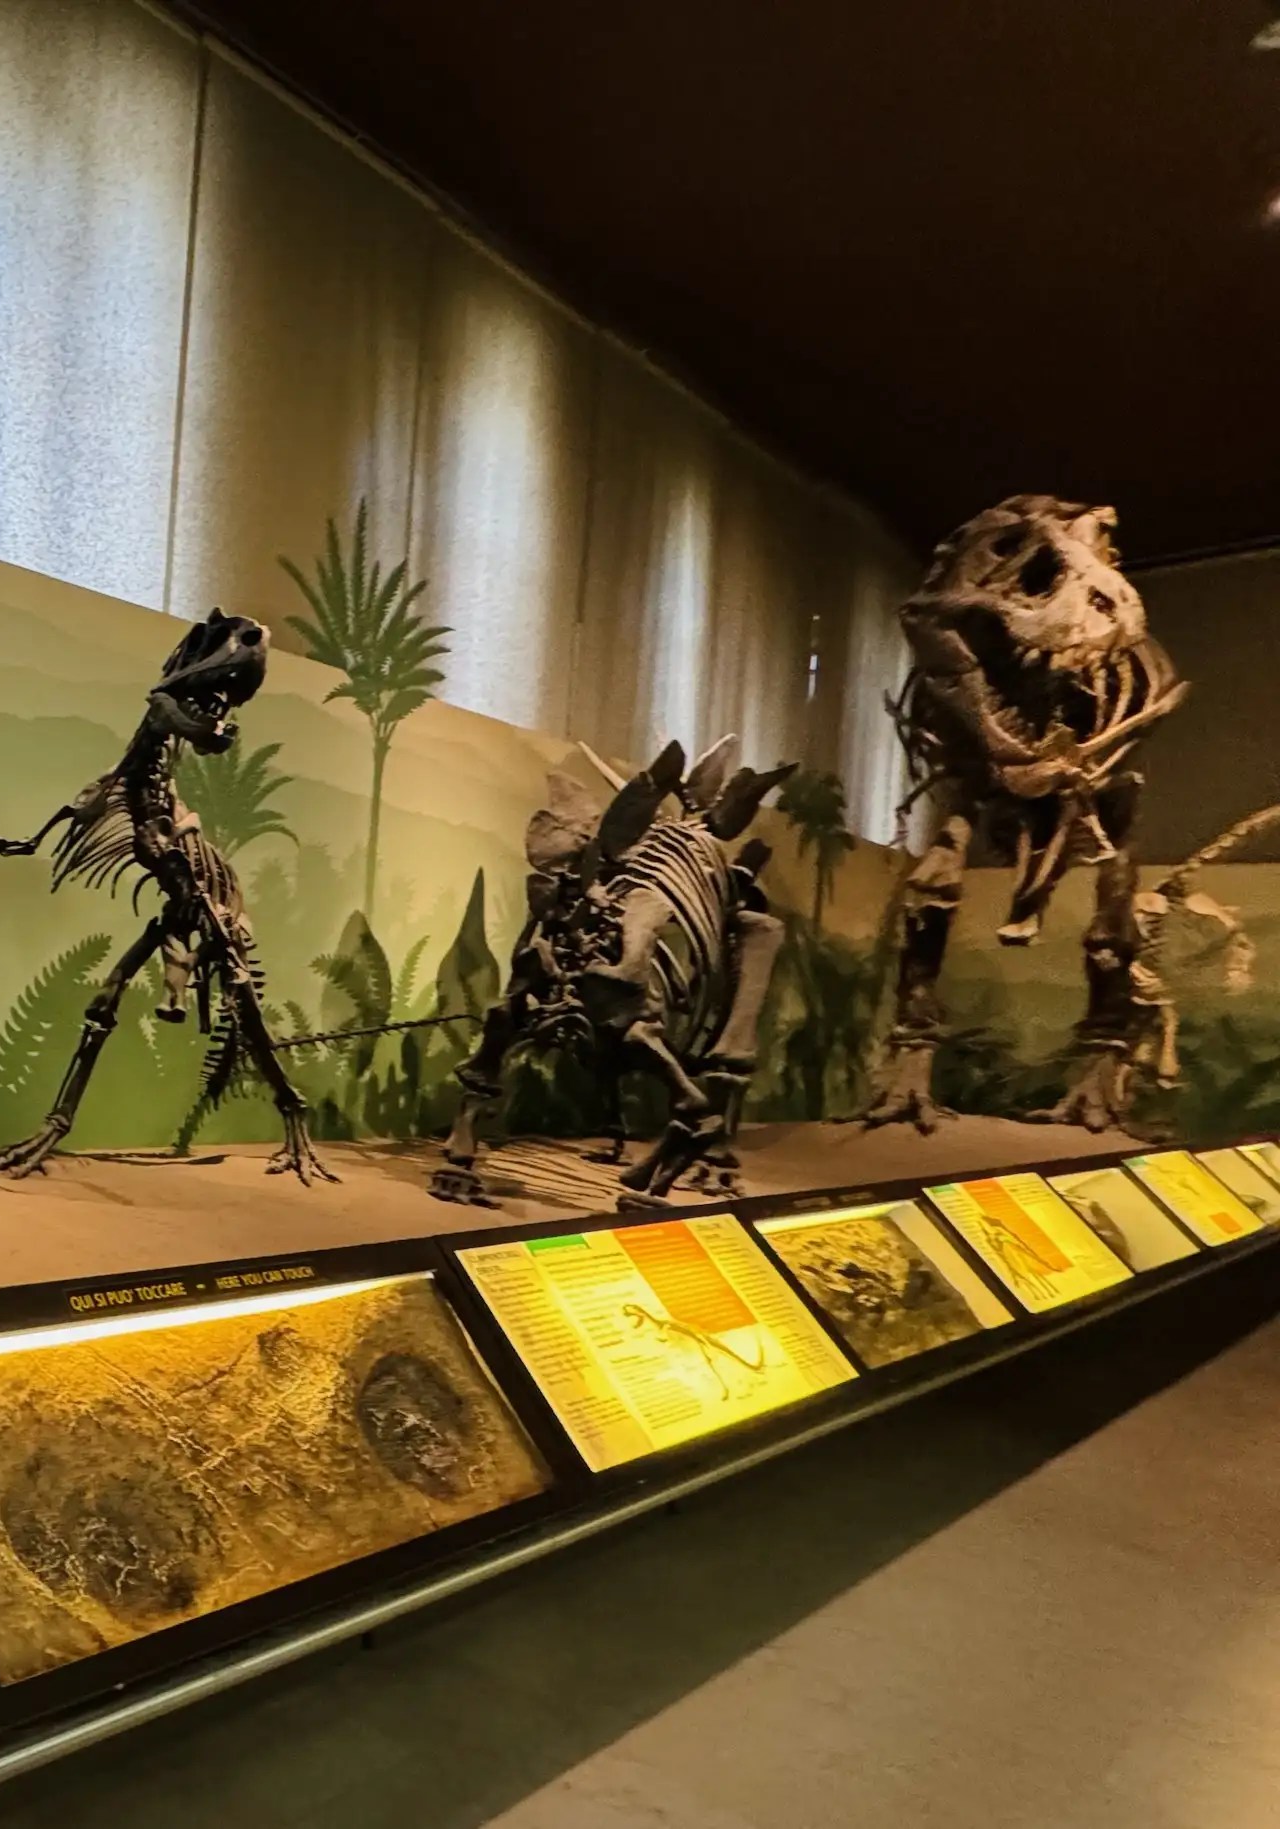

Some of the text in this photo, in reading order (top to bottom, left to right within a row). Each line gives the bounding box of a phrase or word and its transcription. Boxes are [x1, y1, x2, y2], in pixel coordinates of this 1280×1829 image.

[70, 1295, 94, 1311] QUI
[95, 1293, 107, 1307] SI
[136, 1281, 187, 1301] TOCCARE
[215, 1276, 241, 1289] HERE
[242, 1272, 263, 1286] YOU
[264, 1270, 283, 1283] CAN
[284, 1266, 314, 1281] TOUCH
